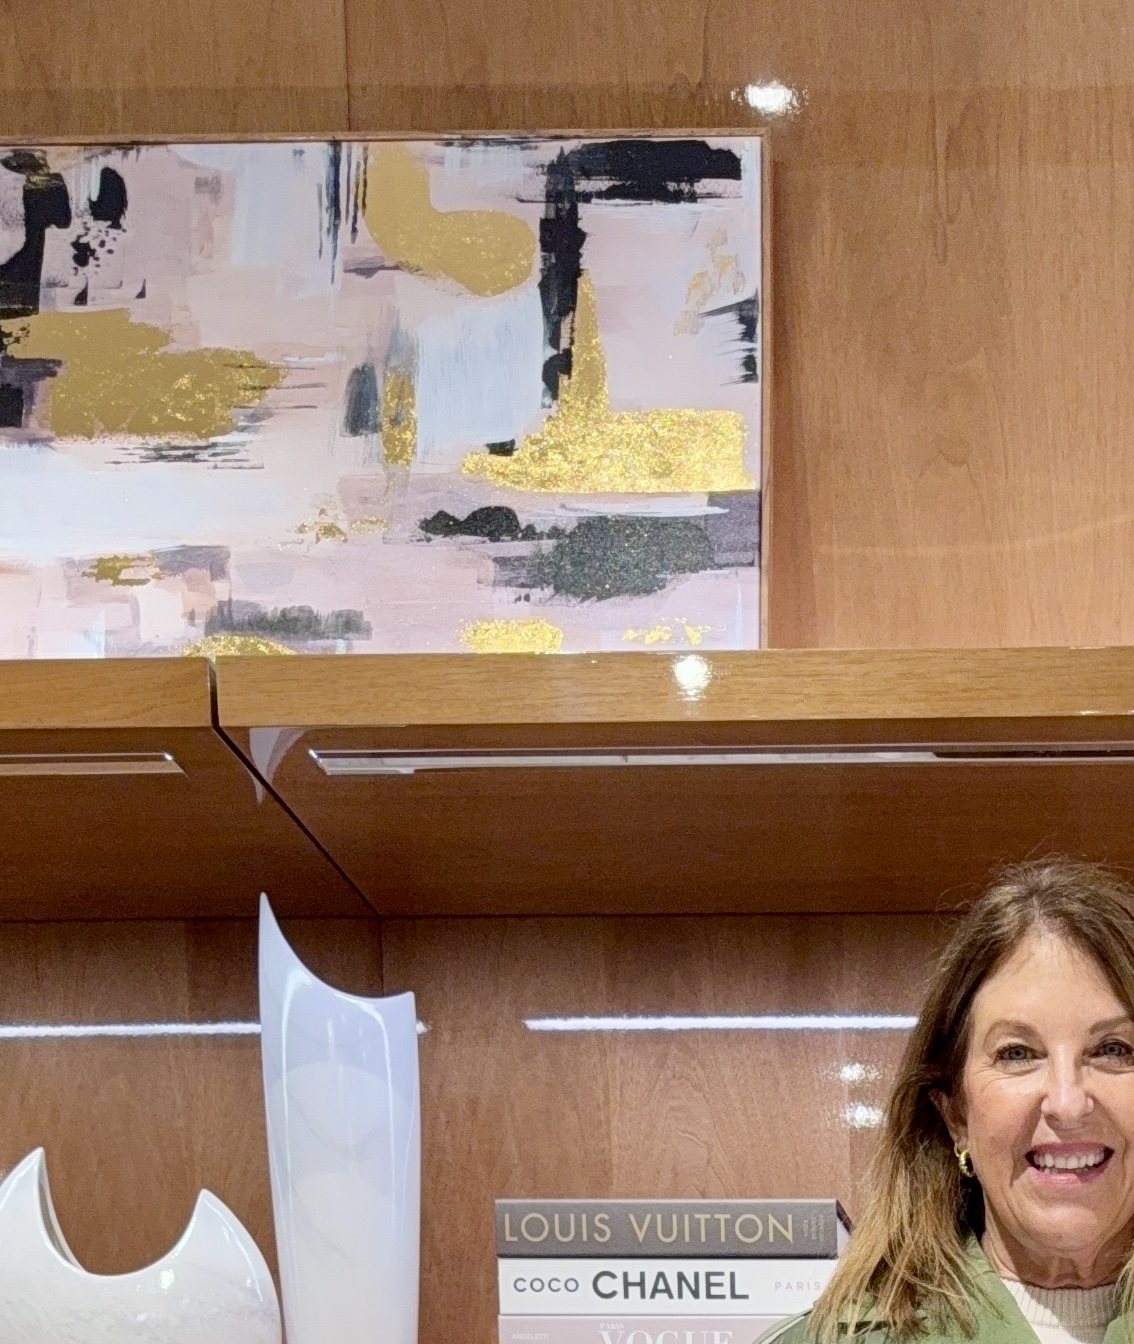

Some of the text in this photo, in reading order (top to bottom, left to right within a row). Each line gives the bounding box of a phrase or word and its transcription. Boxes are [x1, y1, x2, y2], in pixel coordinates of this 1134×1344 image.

[504, 1212, 612, 1243] LOUIS
[628, 1213, 794, 1243] VUITTON
[513, 1270, 821, 1300] COCO CHANEL PARIS
[599, 1322, 625, 1330] PARIS
